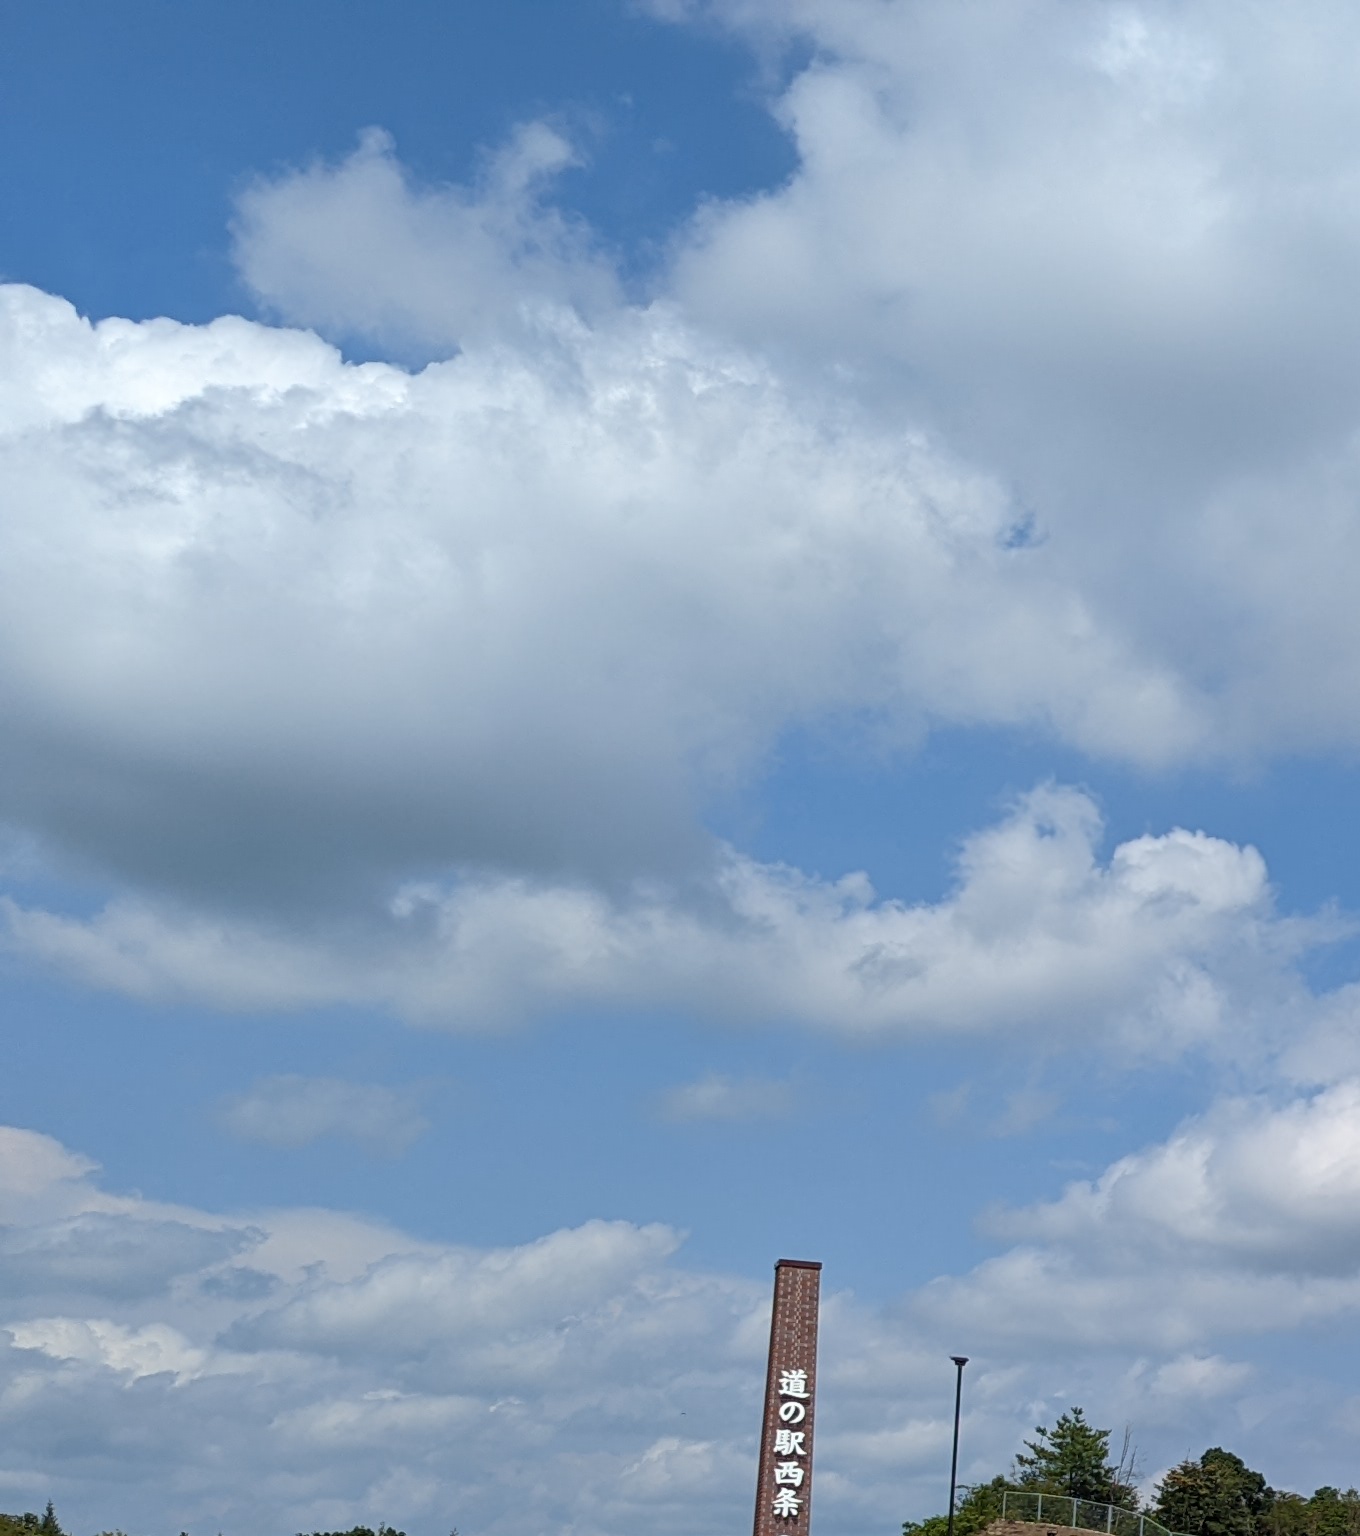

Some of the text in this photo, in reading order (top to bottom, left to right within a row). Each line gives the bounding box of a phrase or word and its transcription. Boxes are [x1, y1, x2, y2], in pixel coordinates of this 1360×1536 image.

[772, 1369, 810, 1518] 道の駅西条
